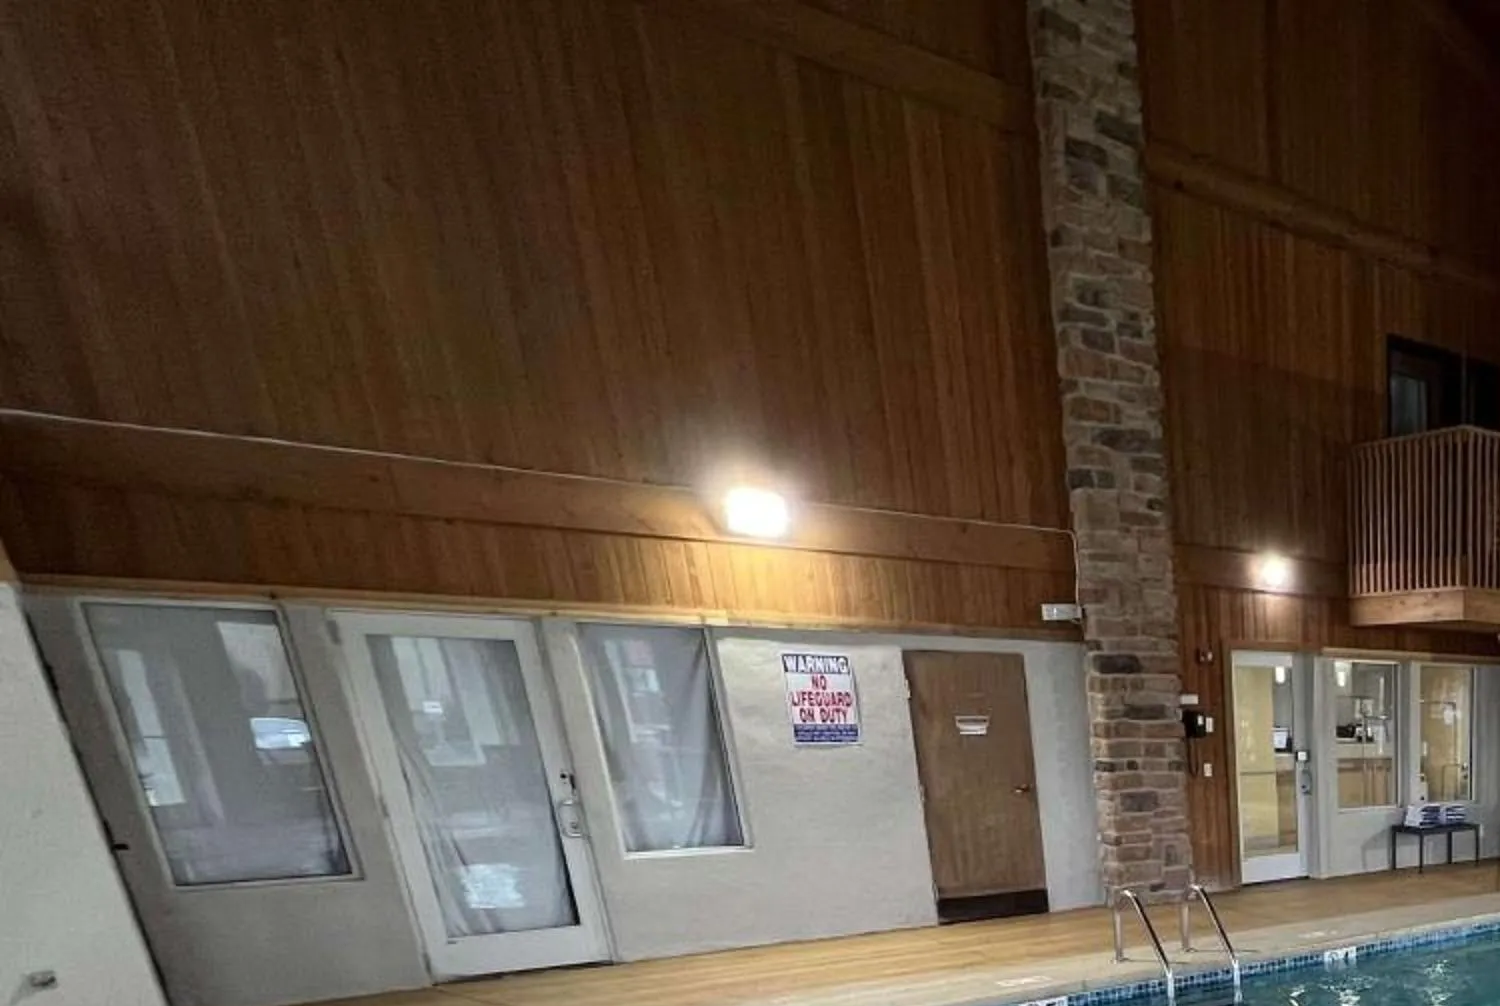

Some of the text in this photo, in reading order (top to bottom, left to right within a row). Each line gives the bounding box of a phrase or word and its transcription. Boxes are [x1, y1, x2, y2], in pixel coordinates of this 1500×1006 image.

[784, 655, 848, 673] WARNING
[811, 675, 827, 690] NO
[791, 691, 852, 706] LIFEGUARD
[800, 707, 847, 722] ON DUTY
